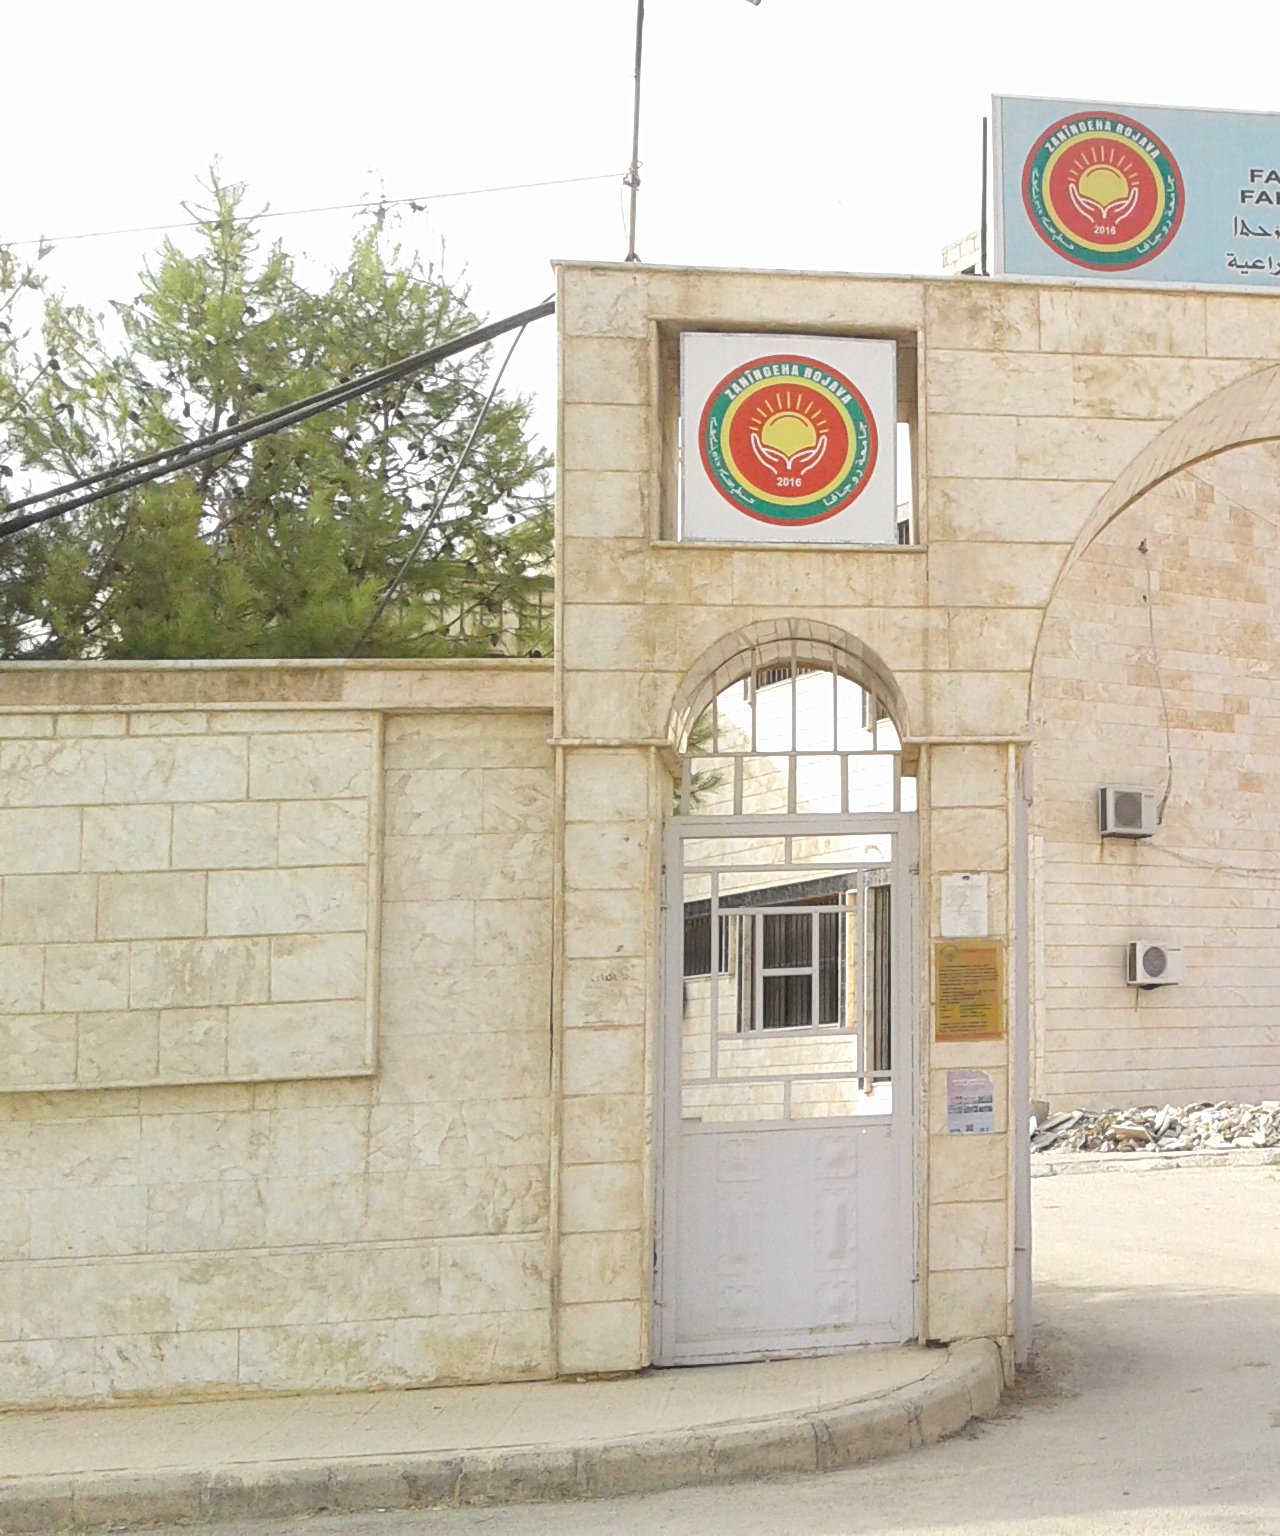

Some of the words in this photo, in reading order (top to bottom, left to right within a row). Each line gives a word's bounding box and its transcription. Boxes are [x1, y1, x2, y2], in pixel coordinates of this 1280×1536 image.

[1044, 119, 1112, 152] ZANÎNGEHA
[1116, 123, 1161, 159] ROJAVA
[1094, 225, 1117, 235] 2016
[724, 362, 799, 401] ZANÎNGEHA
[804, 367, 853, 406] ROJAVA
[776, 477, 802, 488] 2016
